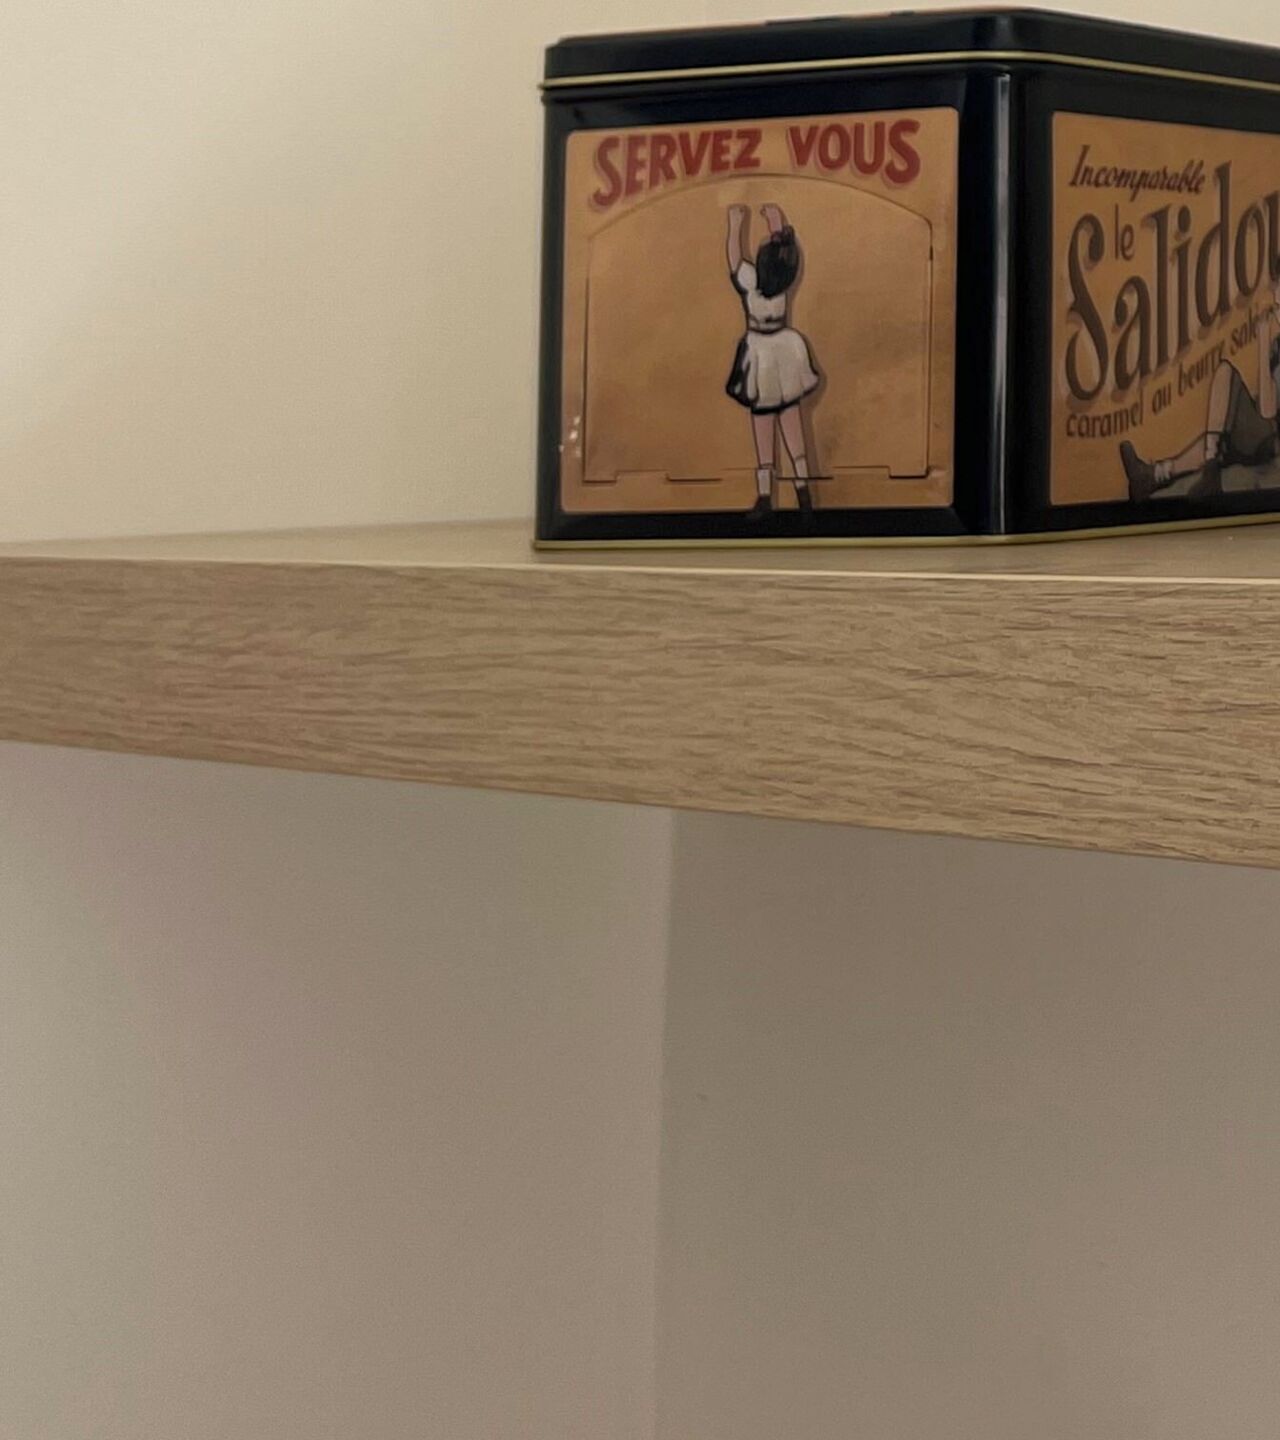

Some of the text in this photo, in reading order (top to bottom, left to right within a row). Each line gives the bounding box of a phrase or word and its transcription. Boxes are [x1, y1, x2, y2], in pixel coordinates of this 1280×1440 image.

[591, 118, 922, 208] SERVEZ VOUS
[1068, 144, 1206, 202] Incomparable
[1115, 203, 1135, 262] le
[1066, 386, 1144, 439] caramel
[1152, 381, 1172, 415] au
